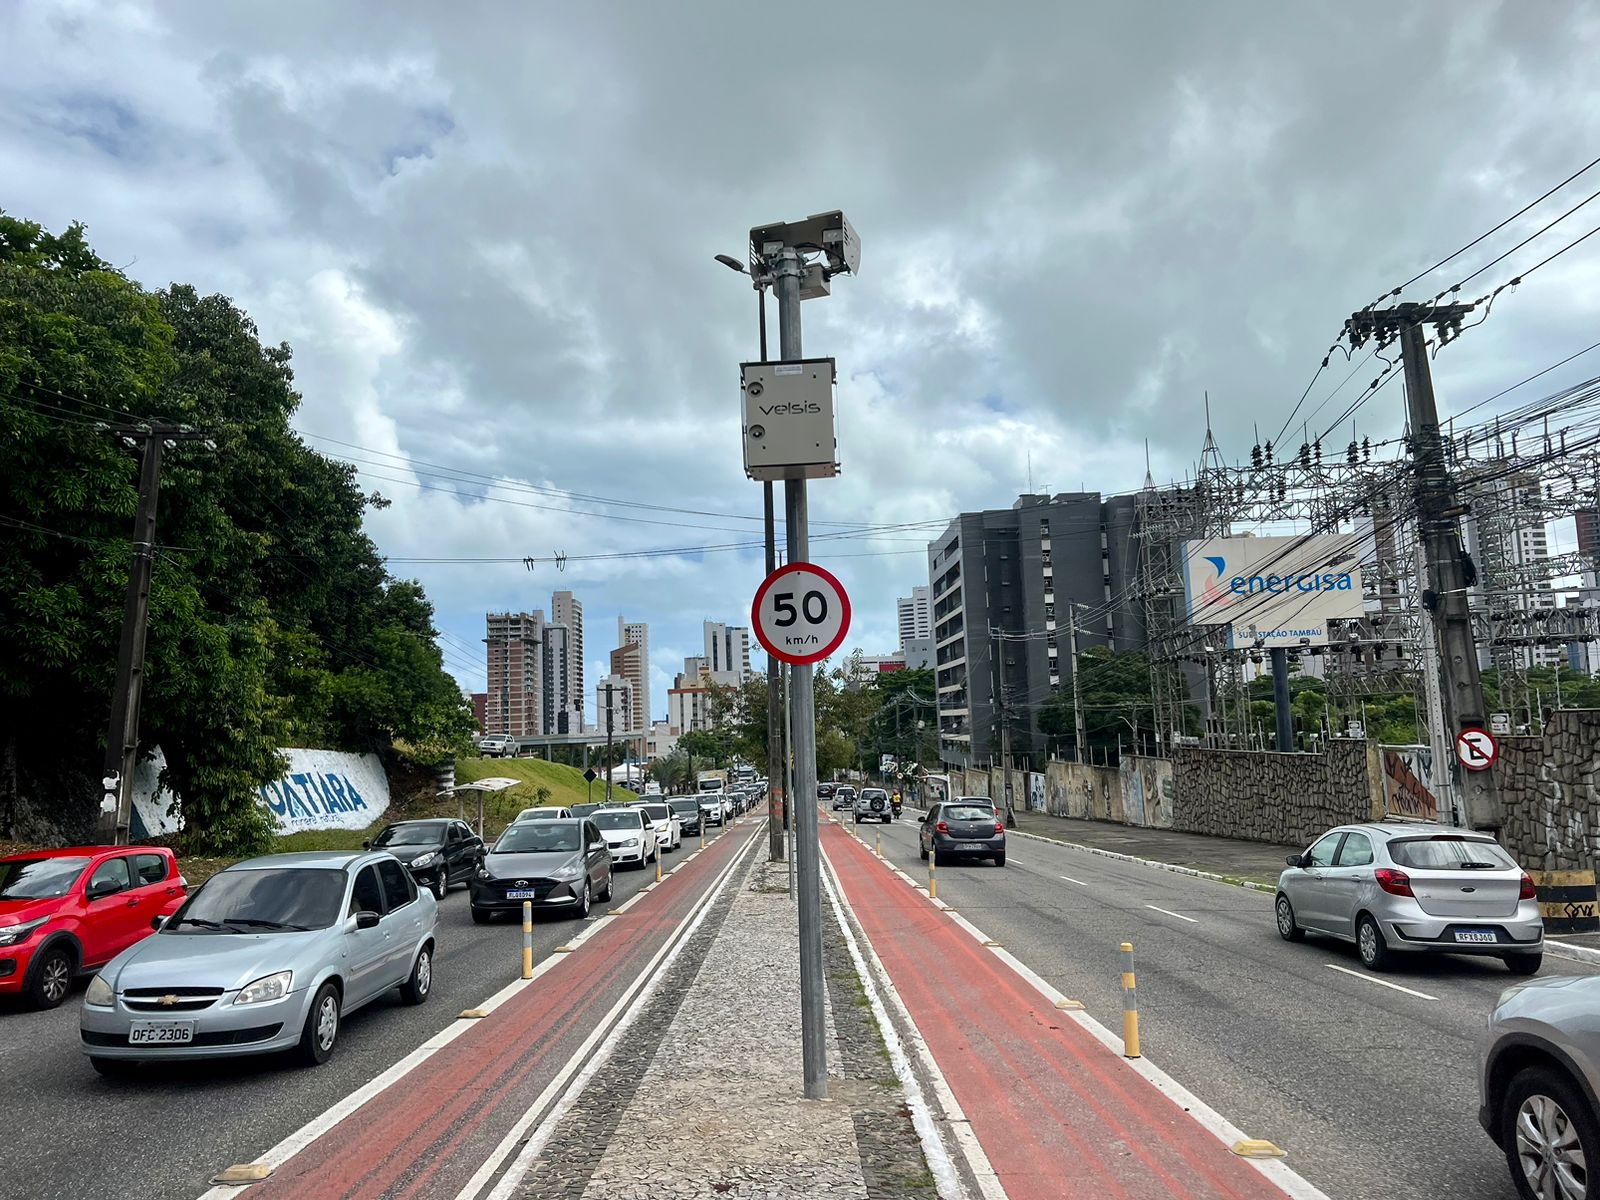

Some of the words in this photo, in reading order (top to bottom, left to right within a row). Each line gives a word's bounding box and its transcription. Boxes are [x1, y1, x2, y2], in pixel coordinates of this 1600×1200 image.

[759, 400, 821, 415] velsis
[774, 590, 828, 627] 50
[785, 634, 819, 645] km/h
[1238, 629, 1288, 639] SUBSTAÇÃO
[260, 771, 368, 818] OATIARA
